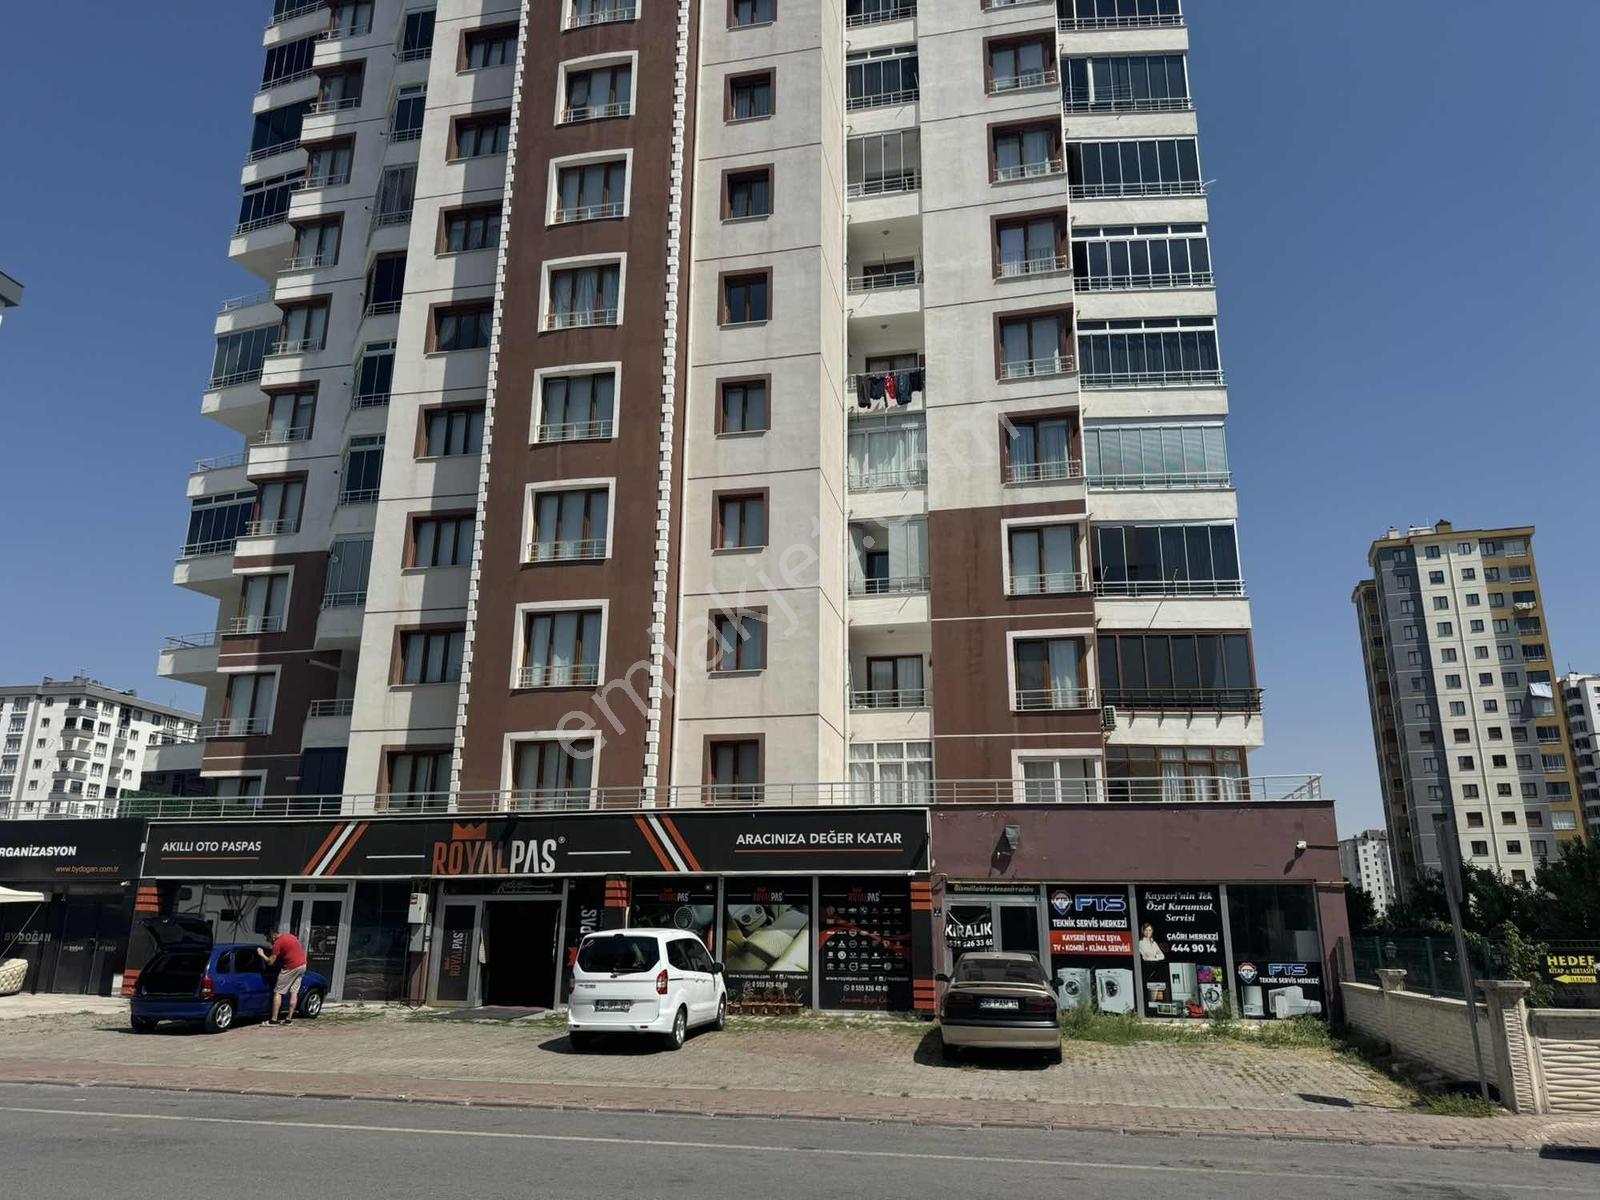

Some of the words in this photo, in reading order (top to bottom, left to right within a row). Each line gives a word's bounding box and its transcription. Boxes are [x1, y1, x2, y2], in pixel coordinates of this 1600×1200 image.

[736, 833, 805, 845] ARACINIZA
[810, 830, 853, 844] DEĞER
[857, 832, 902, 844] KATAR
[162, 841, 194, 852] AKILLI
[196, 841, 219, 851] OTO
[221, 840, 262, 851] PASPAS
[1199, 892, 1213, 900] Tek
[1075, 894, 1126, 912] FTS
[1146, 900, 1166, 911] Özel
[1168, 903, 1213, 911] Kurumsal
[1052, 917, 1075, 928] TEKNİK
[1076, 917, 1098, 928] SERVİS
[1100, 917, 1127, 928] MERKEZİ
[1165, 913, 1195, 922] Servisi
[945, 922, 992, 937] KİRALIK
[1189, 932, 1219, 940] MERKEZİ
[1171, 944, 1190, 952] 444
[1192, 944, 1204, 952] 90
[1206, 944, 1217, 953] 14
[1547, 955, 1595, 966] HEDEF
[1268, 963, 1308, 976] FTS
